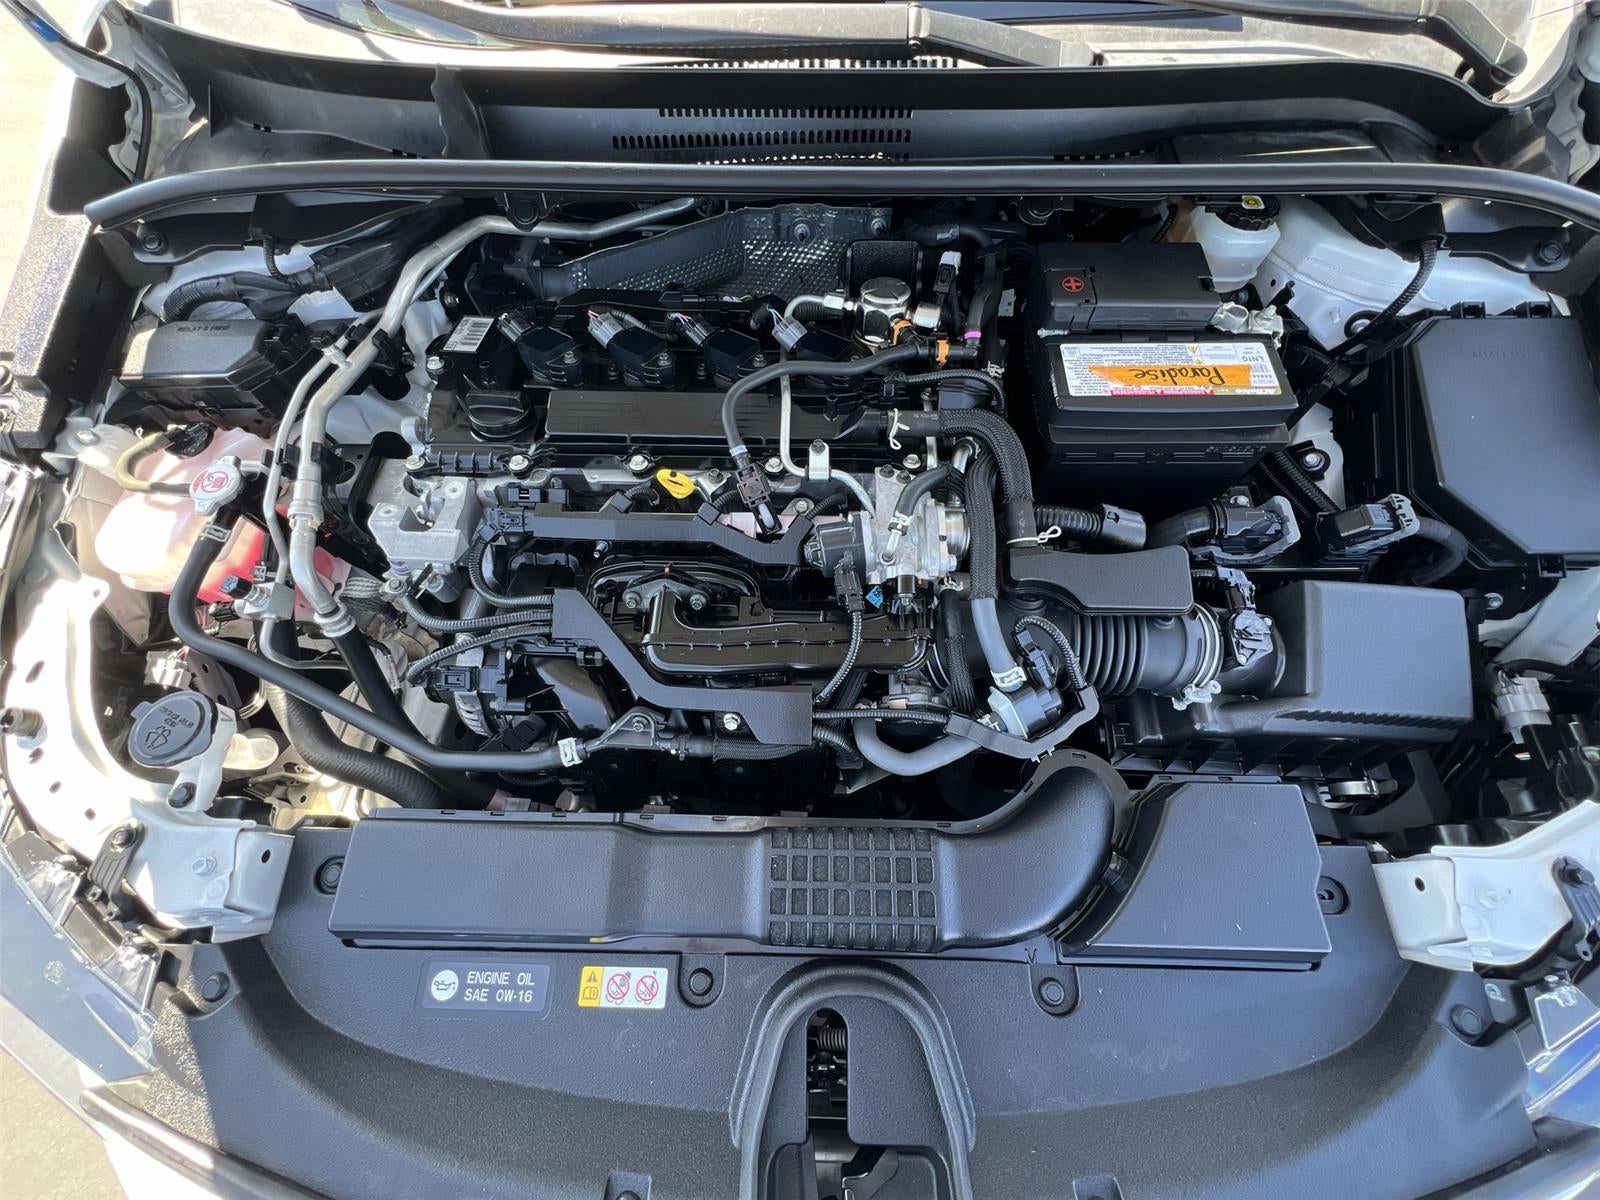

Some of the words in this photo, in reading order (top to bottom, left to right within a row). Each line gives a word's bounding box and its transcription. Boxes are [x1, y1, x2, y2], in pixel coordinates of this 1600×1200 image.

[1129, 366, 1226, 386] Paradise
[466, 971, 510, 985] ENGINE
[517, 973, 535, 985] OIL
[464, 988, 489, 1001] SAE
[496, 989, 533, 1003] 0W-16
